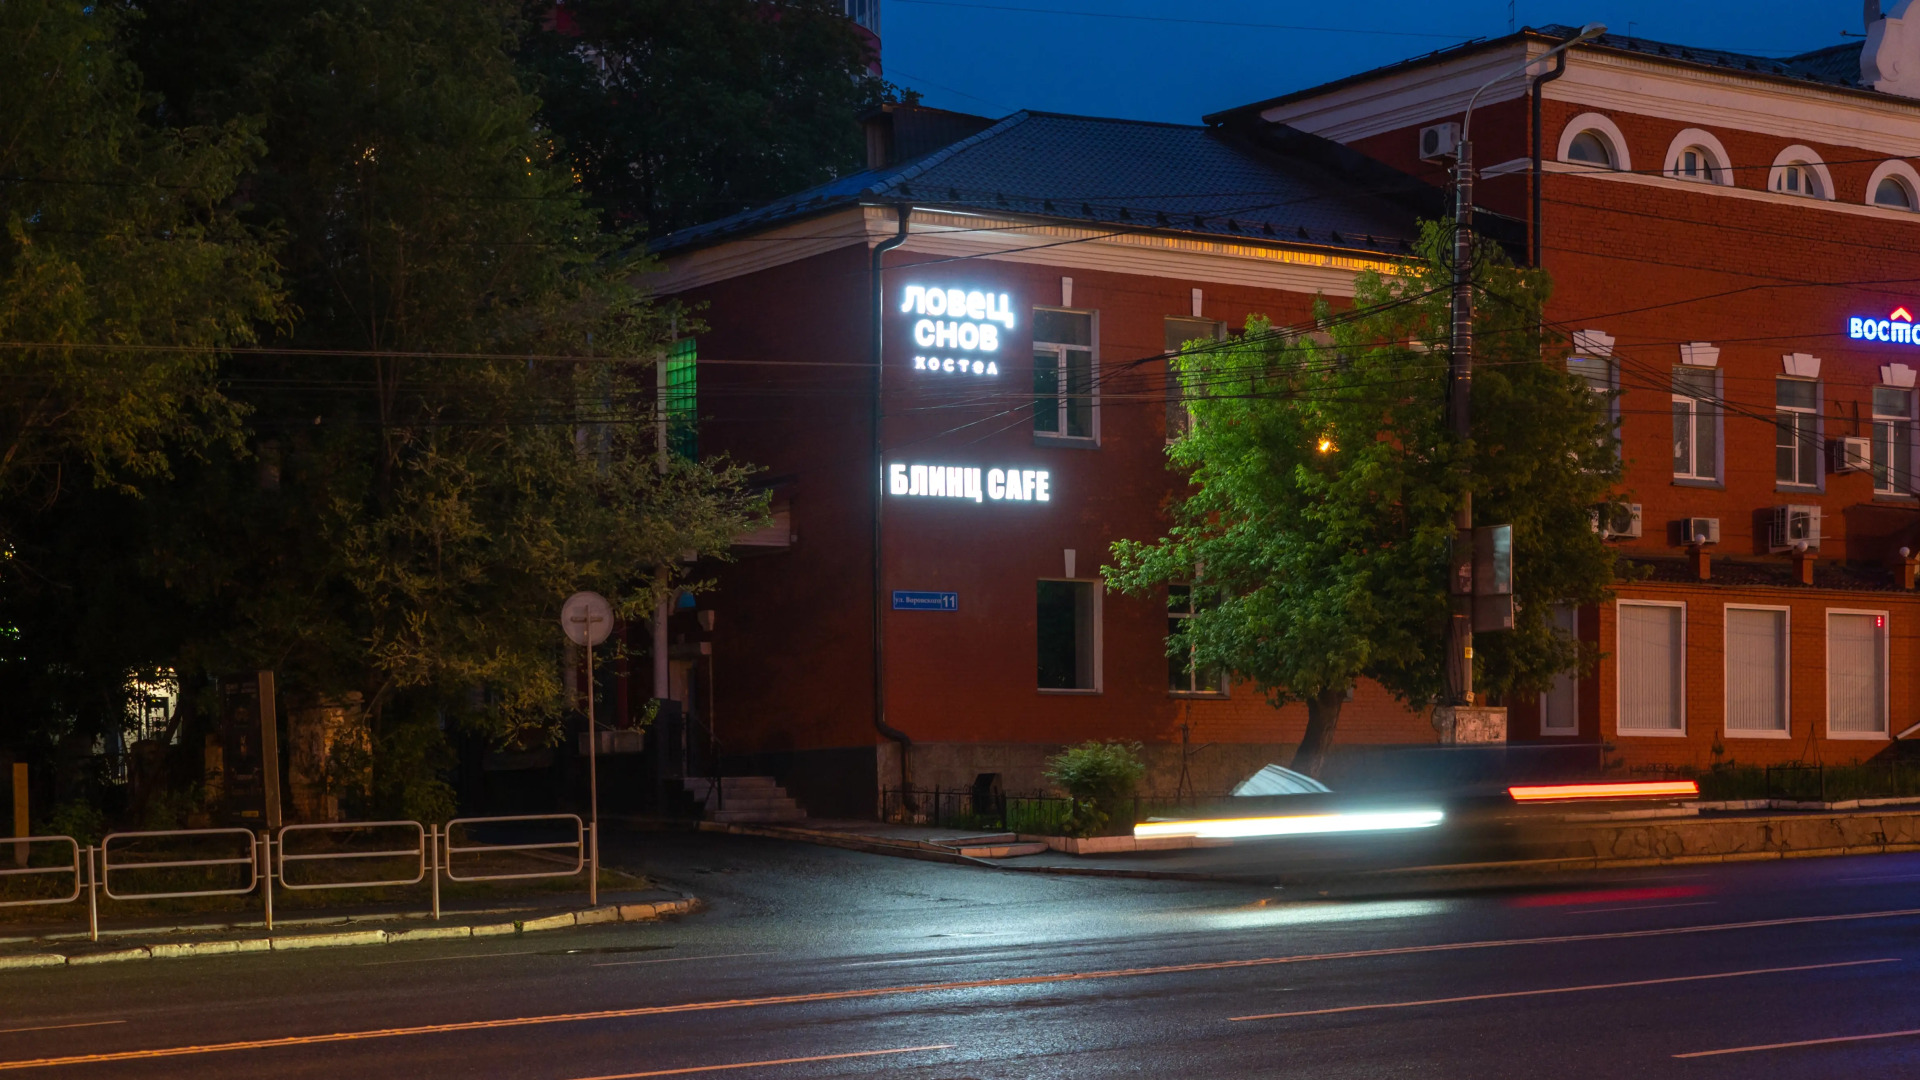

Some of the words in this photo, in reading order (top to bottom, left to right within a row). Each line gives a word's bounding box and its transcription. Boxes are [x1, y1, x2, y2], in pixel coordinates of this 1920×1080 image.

[890, 463, 983, 503] БЛИНЦ
[987, 468, 1050, 502] CAFE
[943, 595, 955, 608] 11
